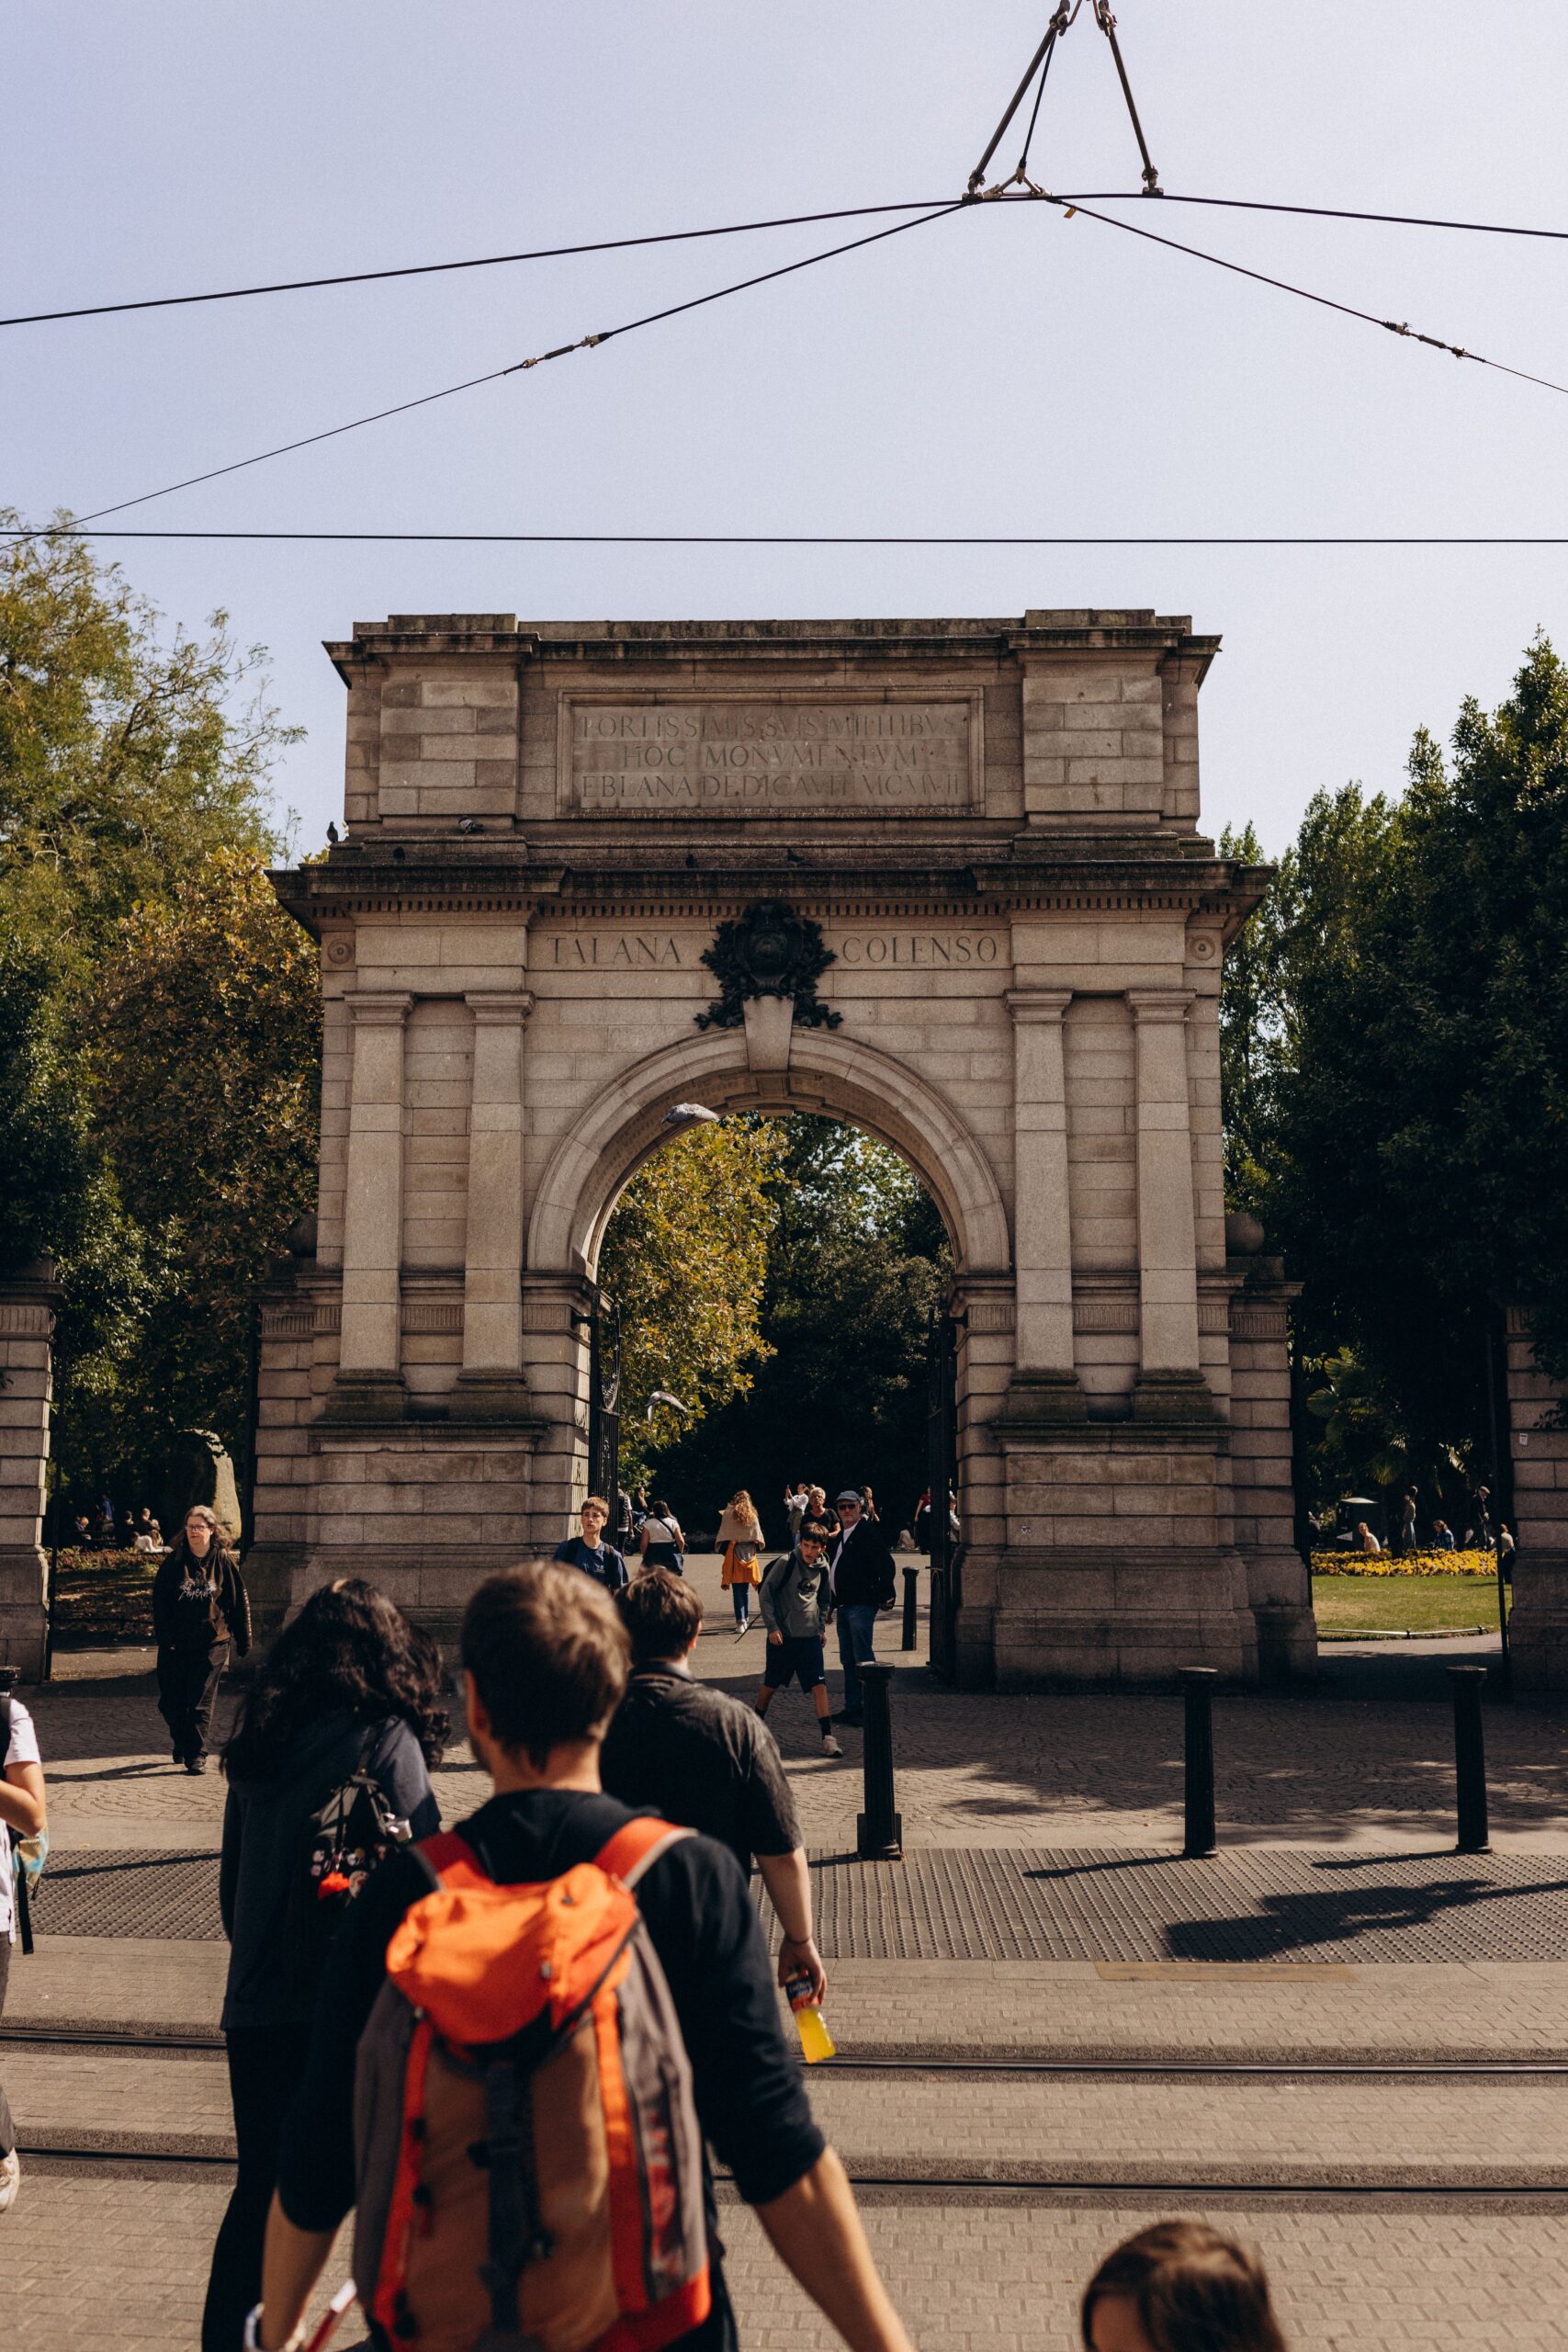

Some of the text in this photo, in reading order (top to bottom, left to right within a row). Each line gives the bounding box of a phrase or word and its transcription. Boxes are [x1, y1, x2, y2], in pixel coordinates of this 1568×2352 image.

[624, 746, 685, 768] HOC
[582, 775, 695, 797] EBLANA
[702, 775, 847, 797] DEDICAVIT
[547, 936, 682, 965] TALANA
[841, 935, 998, 964] COLENSO
